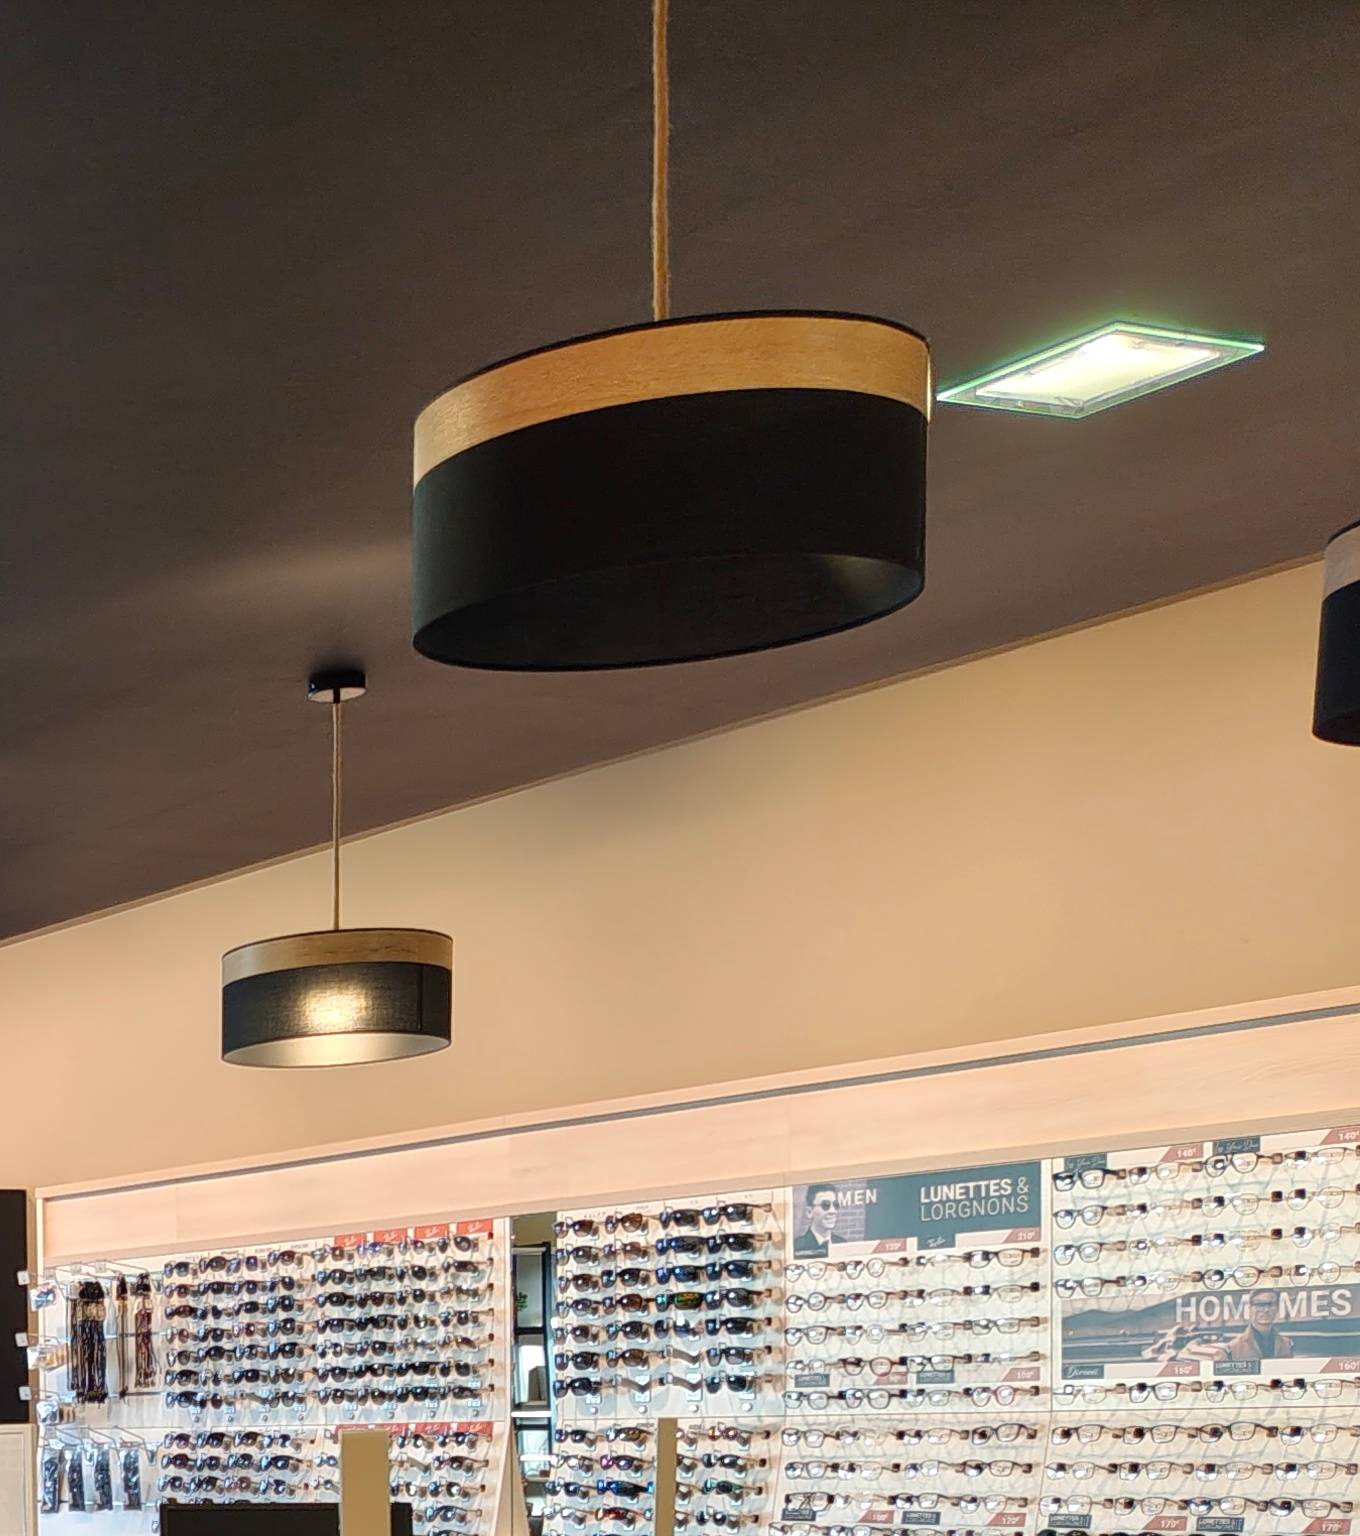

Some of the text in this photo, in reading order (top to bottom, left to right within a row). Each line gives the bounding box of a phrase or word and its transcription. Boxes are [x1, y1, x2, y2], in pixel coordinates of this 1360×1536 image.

[920, 1176, 1029, 1204] LUNETTES &
[920, 1195, 1029, 1222] LORGNONS
